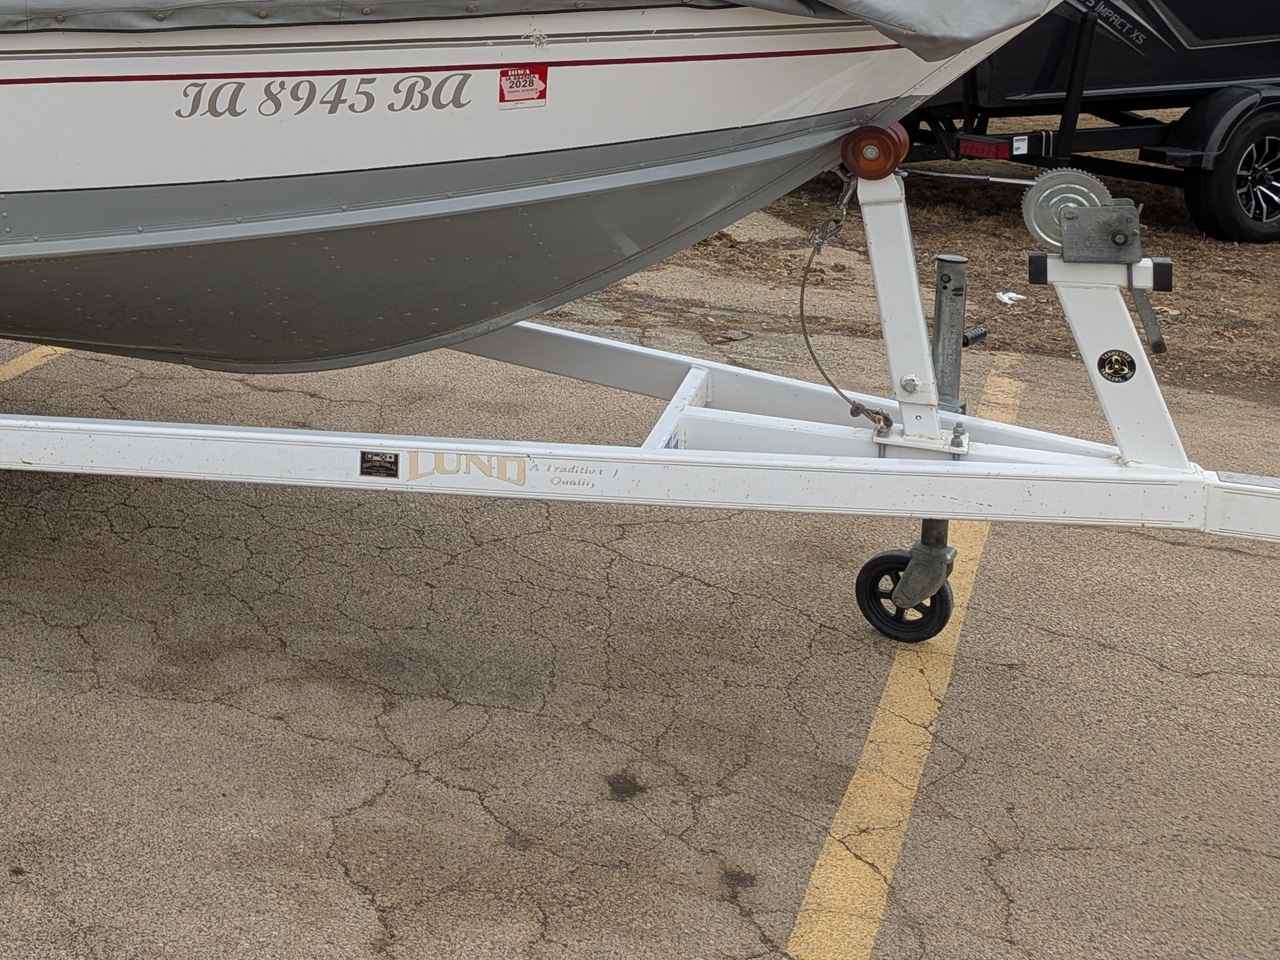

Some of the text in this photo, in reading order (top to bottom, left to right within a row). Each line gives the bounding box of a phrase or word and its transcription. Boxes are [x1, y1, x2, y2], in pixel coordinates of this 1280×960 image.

[258, 77, 377, 117] 8945
[387, 72, 473, 113] BA
[509, 78, 535, 89] 2028
[407, 448, 528, 487] LUND
